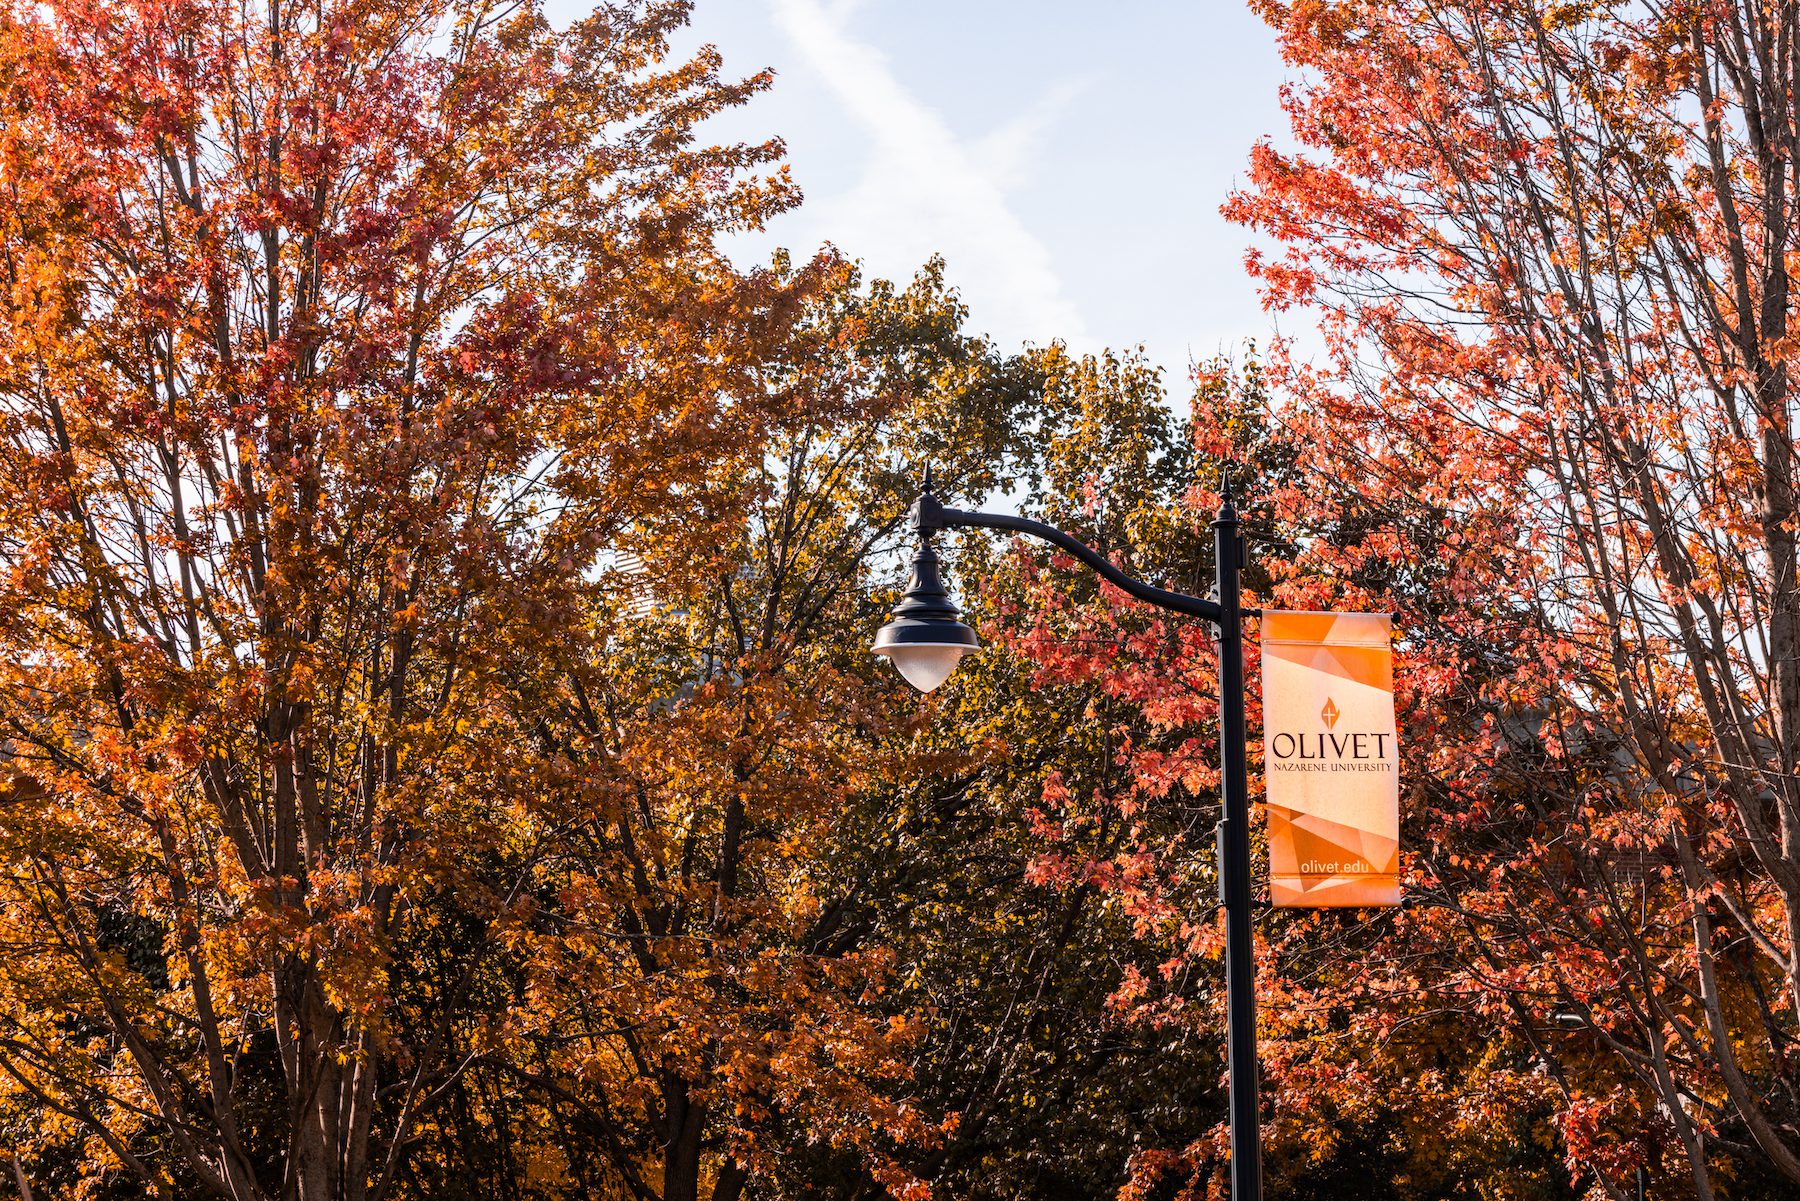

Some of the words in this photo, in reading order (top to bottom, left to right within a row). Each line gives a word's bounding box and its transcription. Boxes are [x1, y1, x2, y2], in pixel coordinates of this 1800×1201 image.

[1272, 732, 1390, 759] OLIVET
[1273, 763, 1327, 772] NAZARENE
[1330, 763, 1392, 772] UNIVERSITY
[1301, 860, 1369, 873] olivet.edu
